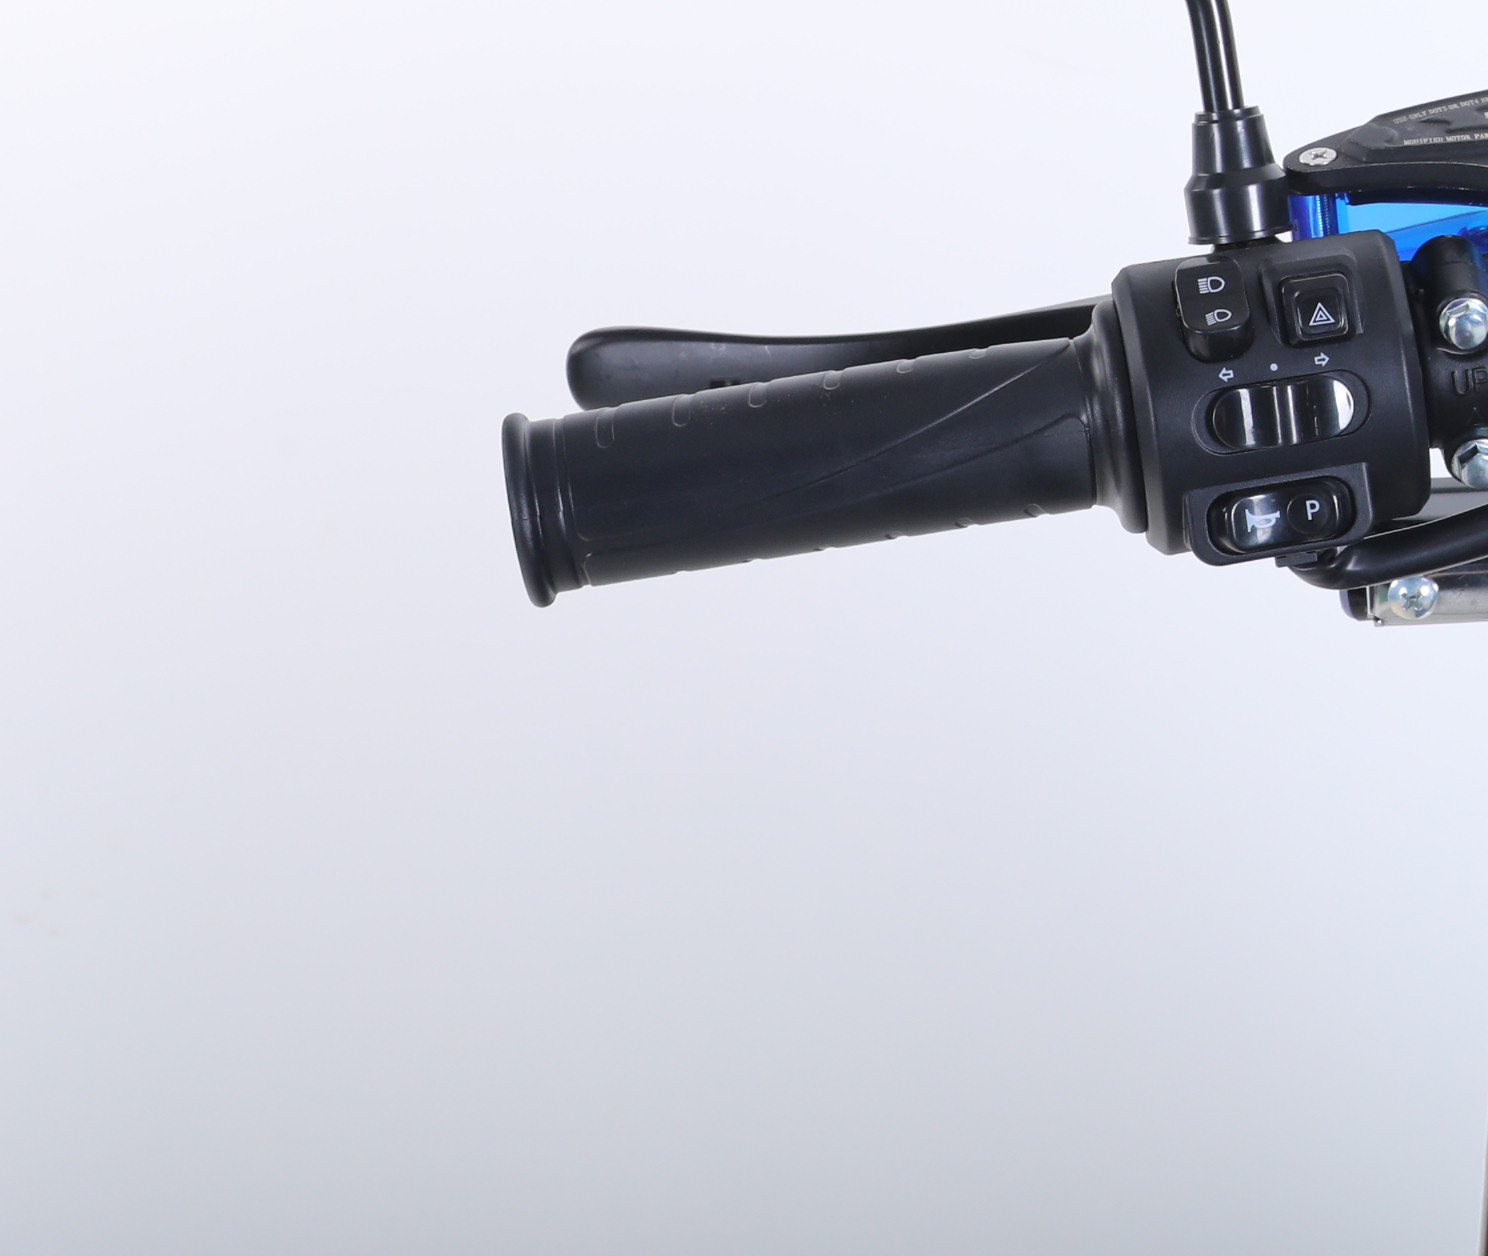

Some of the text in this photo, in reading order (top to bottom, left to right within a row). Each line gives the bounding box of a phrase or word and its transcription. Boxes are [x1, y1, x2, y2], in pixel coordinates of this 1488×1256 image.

[1403, 135, 1444, 146] MODIFIED
[1445, 133, 1471, 142] MOTOR
[1304, 499, 1321, 521] P
